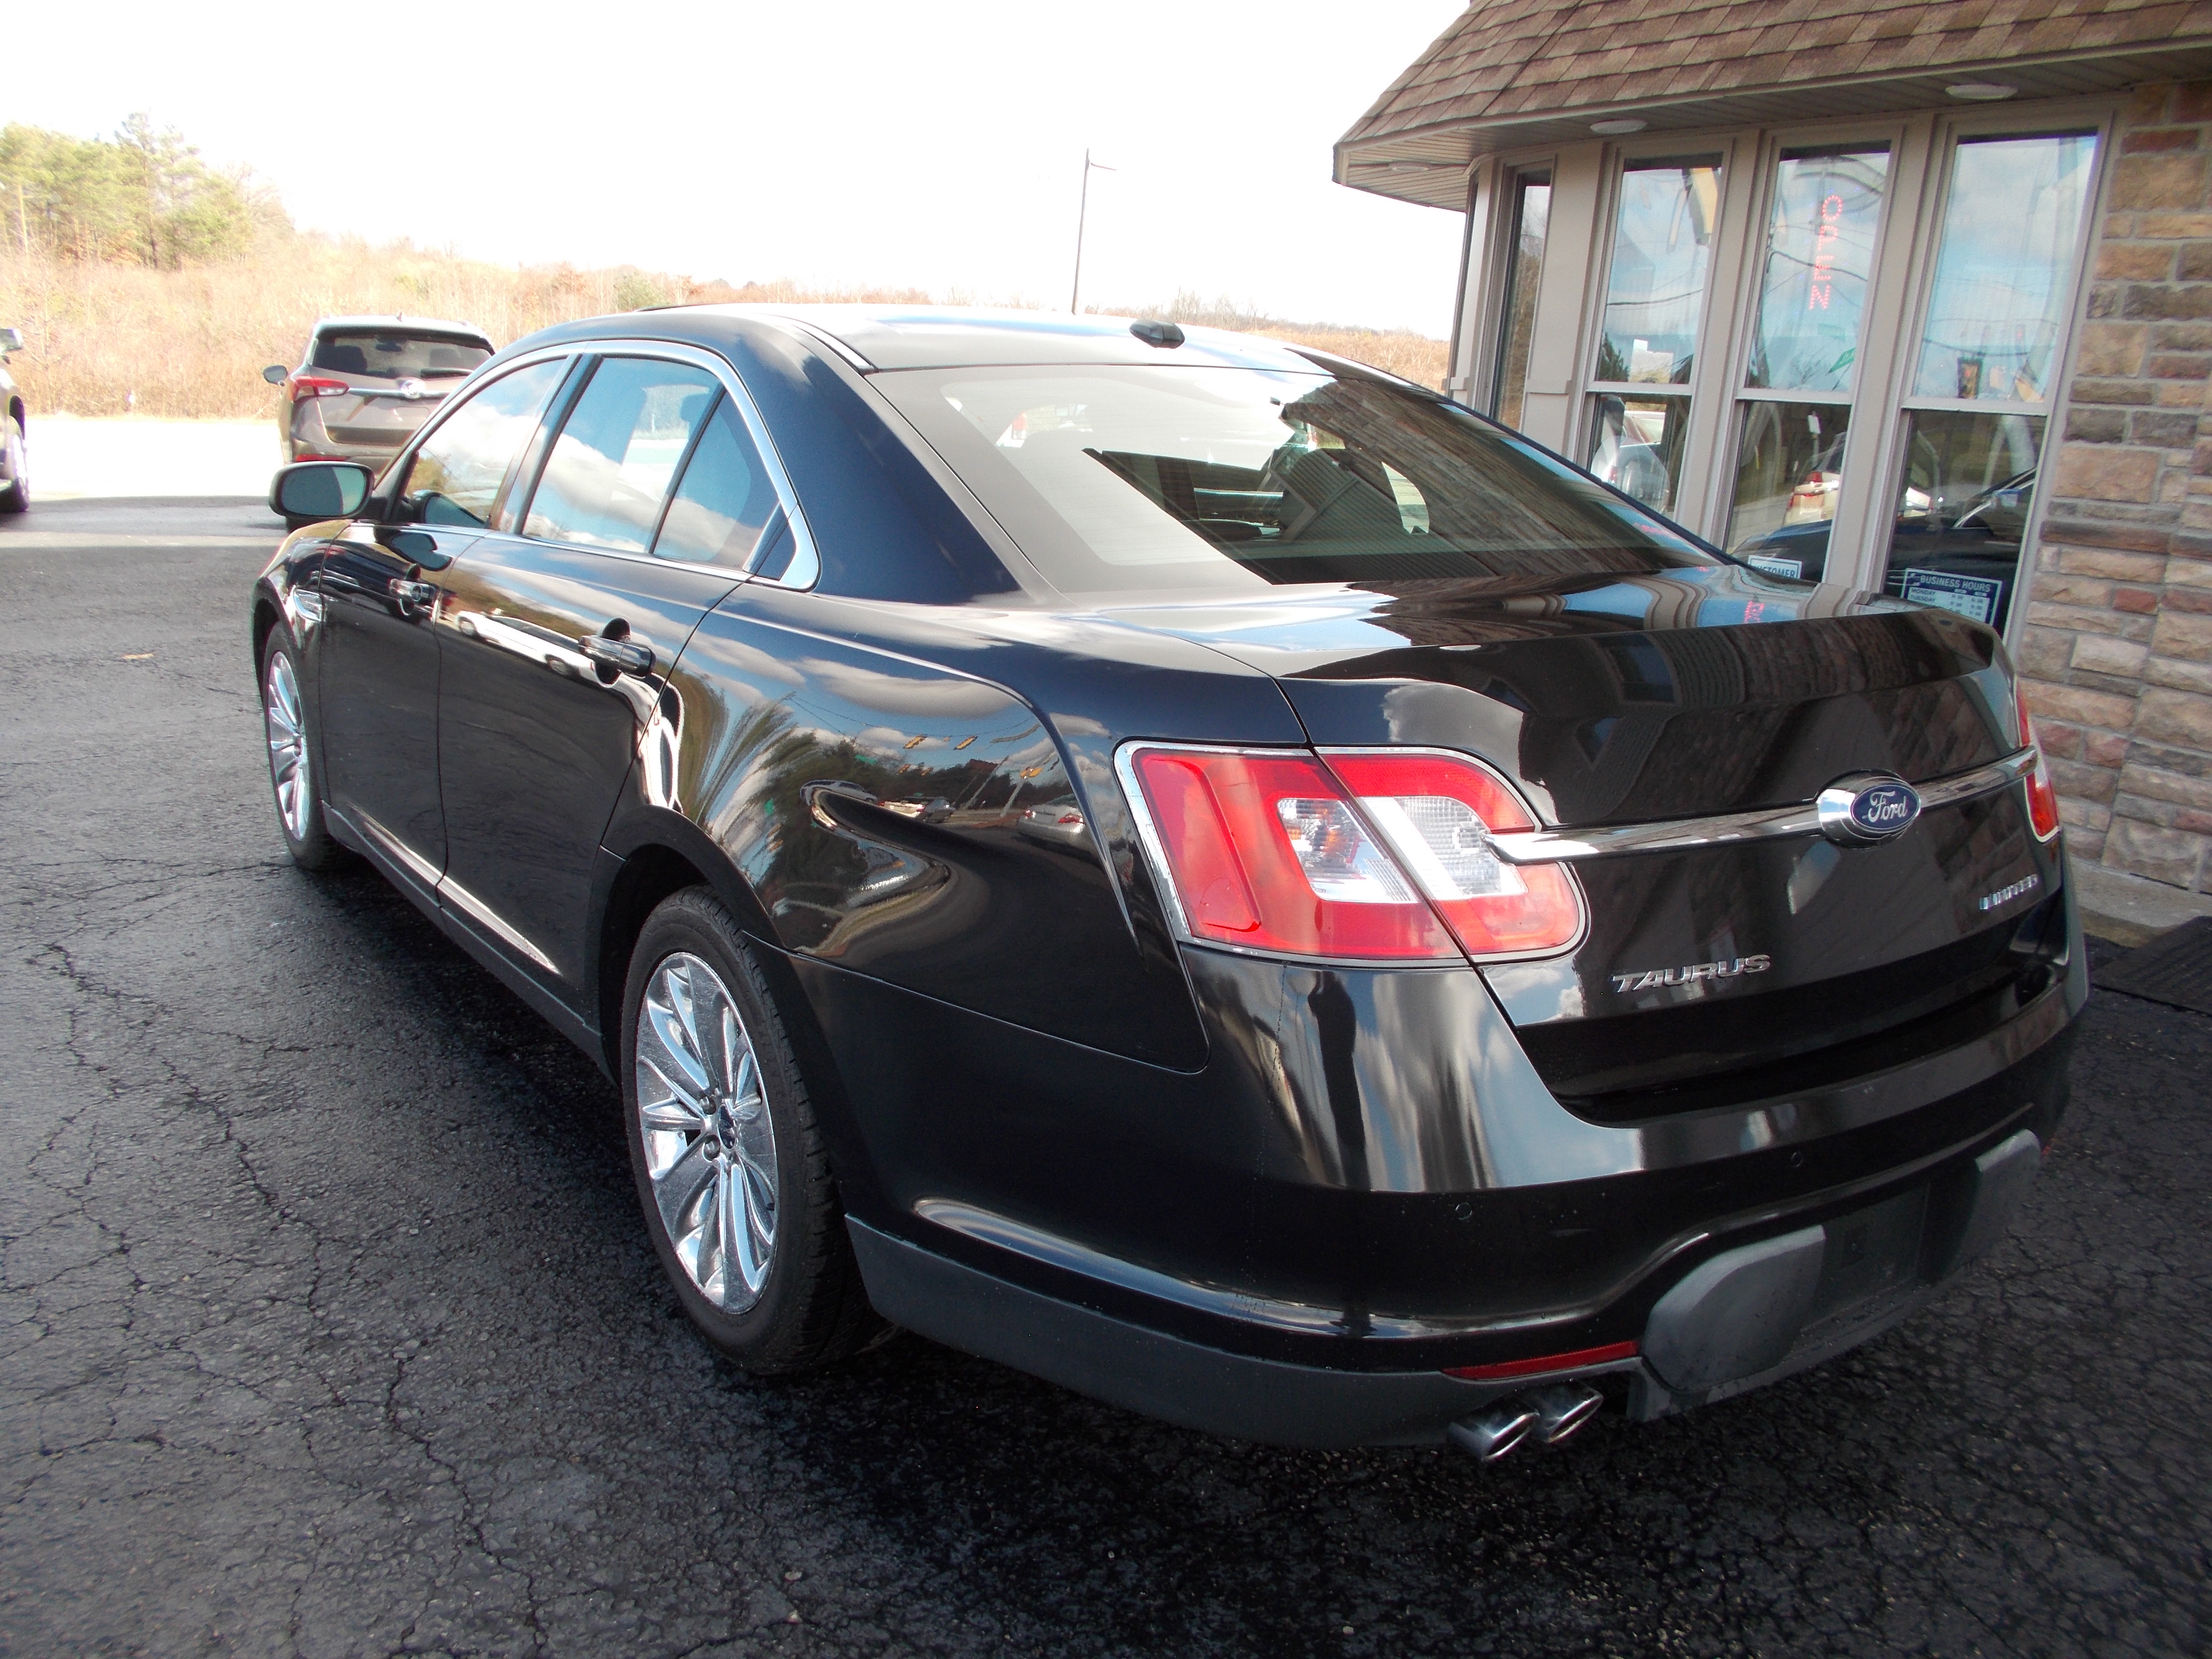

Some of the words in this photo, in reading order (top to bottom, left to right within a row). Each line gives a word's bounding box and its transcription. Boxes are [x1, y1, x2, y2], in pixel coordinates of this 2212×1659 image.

[1808, 194, 1843, 310] OPEN
[1921, 576, 1960, 588] BUSINESS
[1962, 580, 1991, 592] HOURS
[1862, 790, 1908, 823] Ford
[1611, 954, 1771, 993] TAURUS
